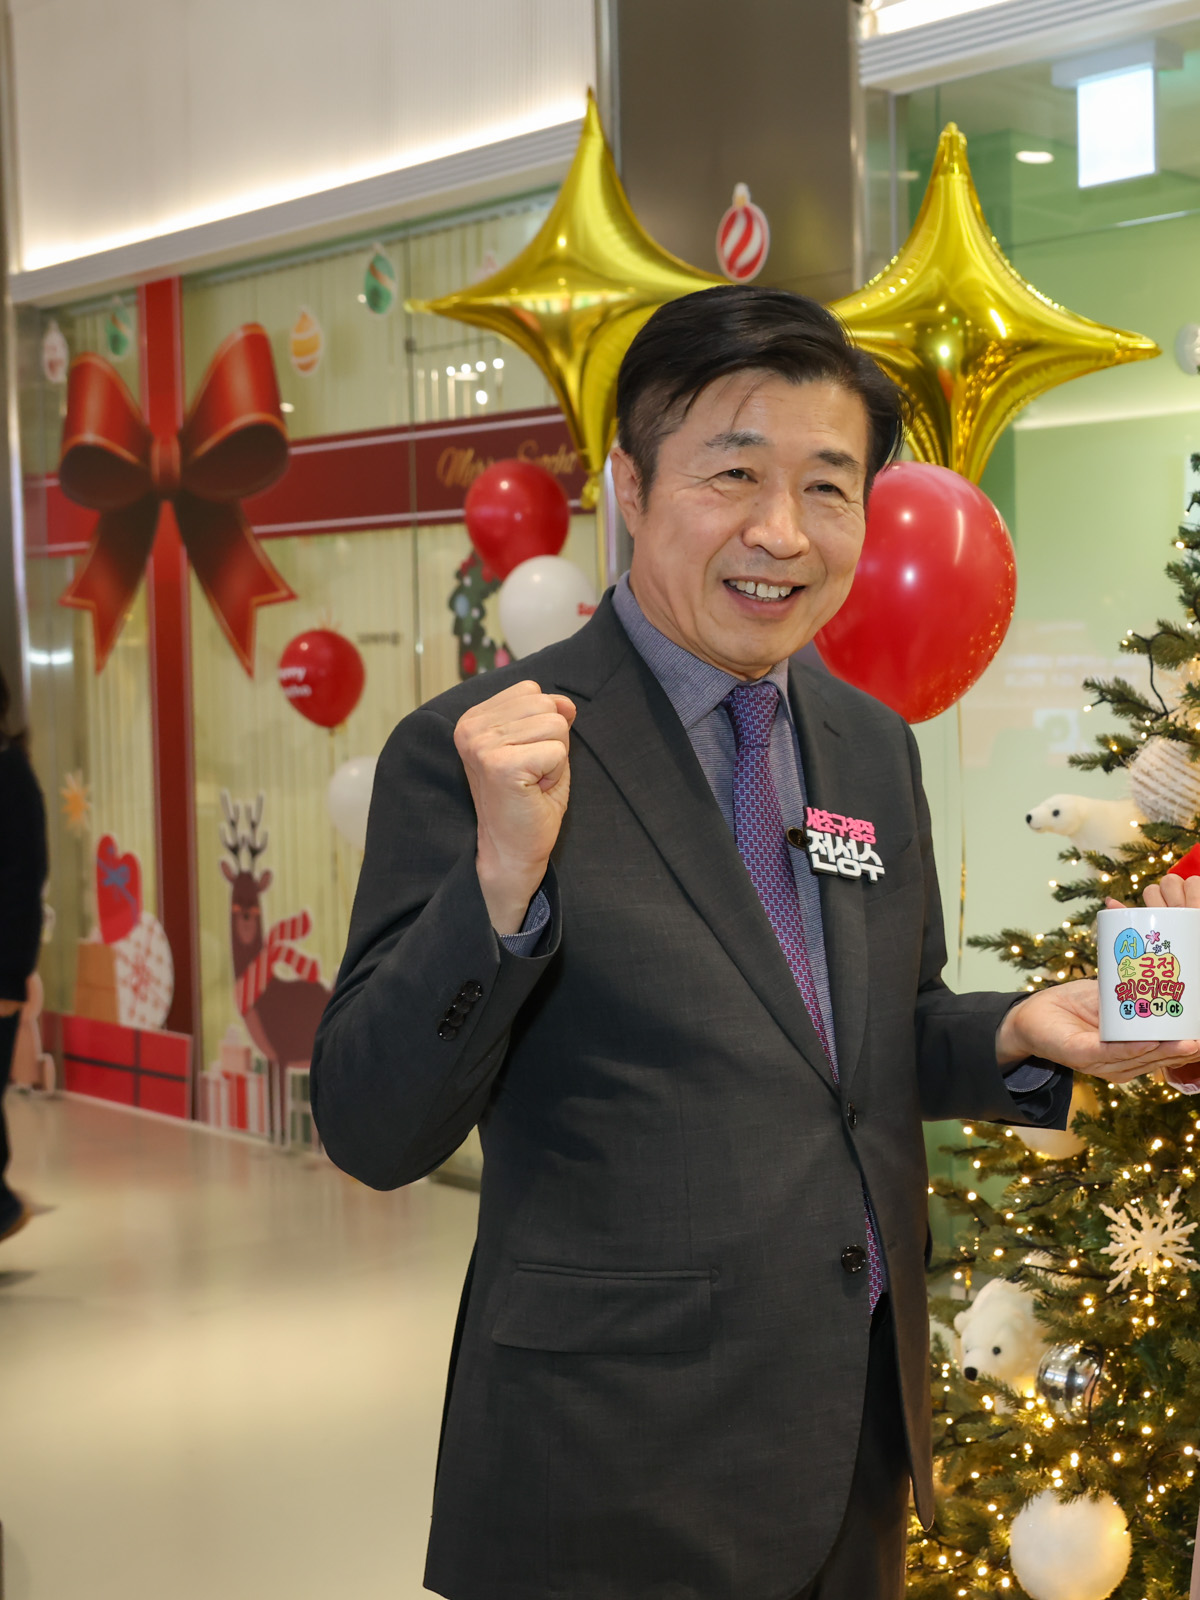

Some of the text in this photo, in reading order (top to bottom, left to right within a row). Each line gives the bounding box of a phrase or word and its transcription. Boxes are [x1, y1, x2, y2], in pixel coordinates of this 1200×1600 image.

[806, 807, 877, 844] 서초구청장
[806, 829, 885, 881] 전성수
[1120, 937, 1137, 957] 서
